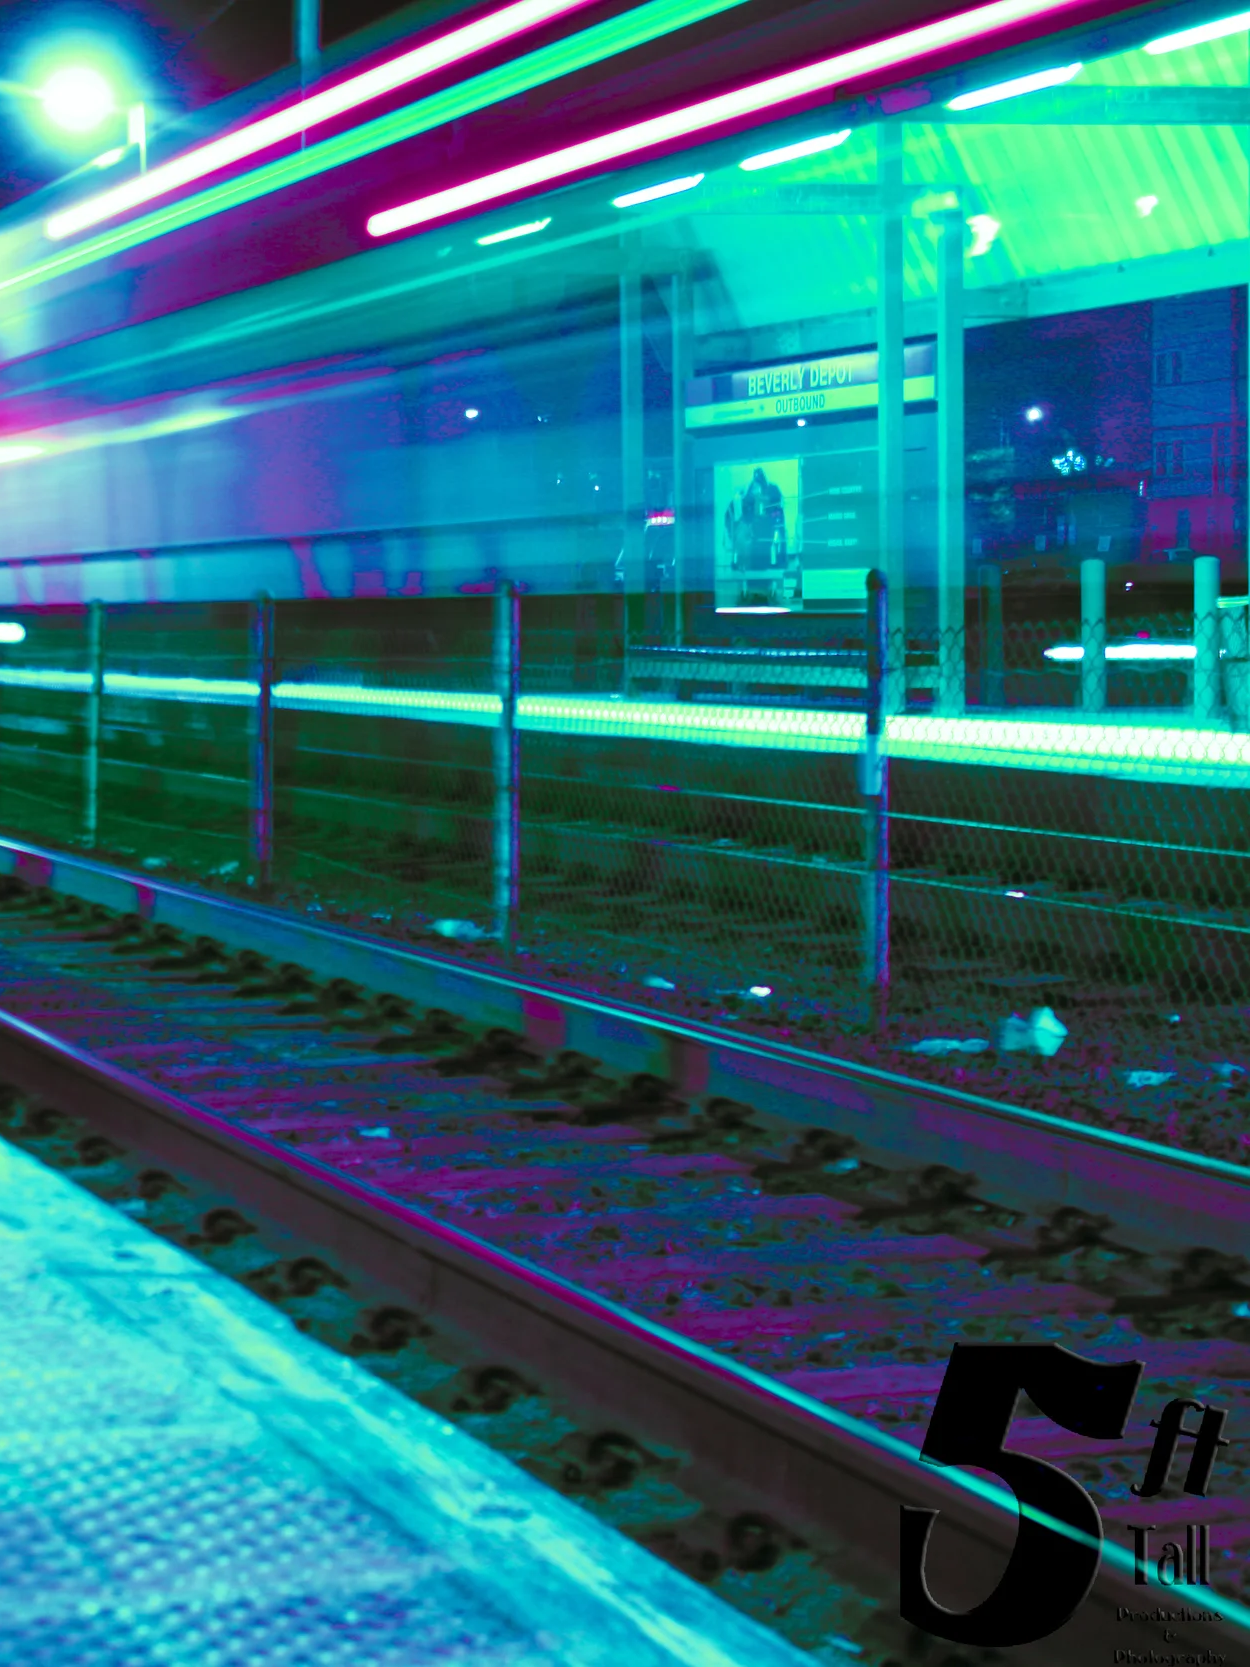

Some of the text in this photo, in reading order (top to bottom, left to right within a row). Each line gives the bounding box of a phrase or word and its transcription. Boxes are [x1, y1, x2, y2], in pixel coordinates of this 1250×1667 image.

[749, 363, 852, 396] BEVERLY DEPOT
[776, 394, 825, 414] OUTBOUND
